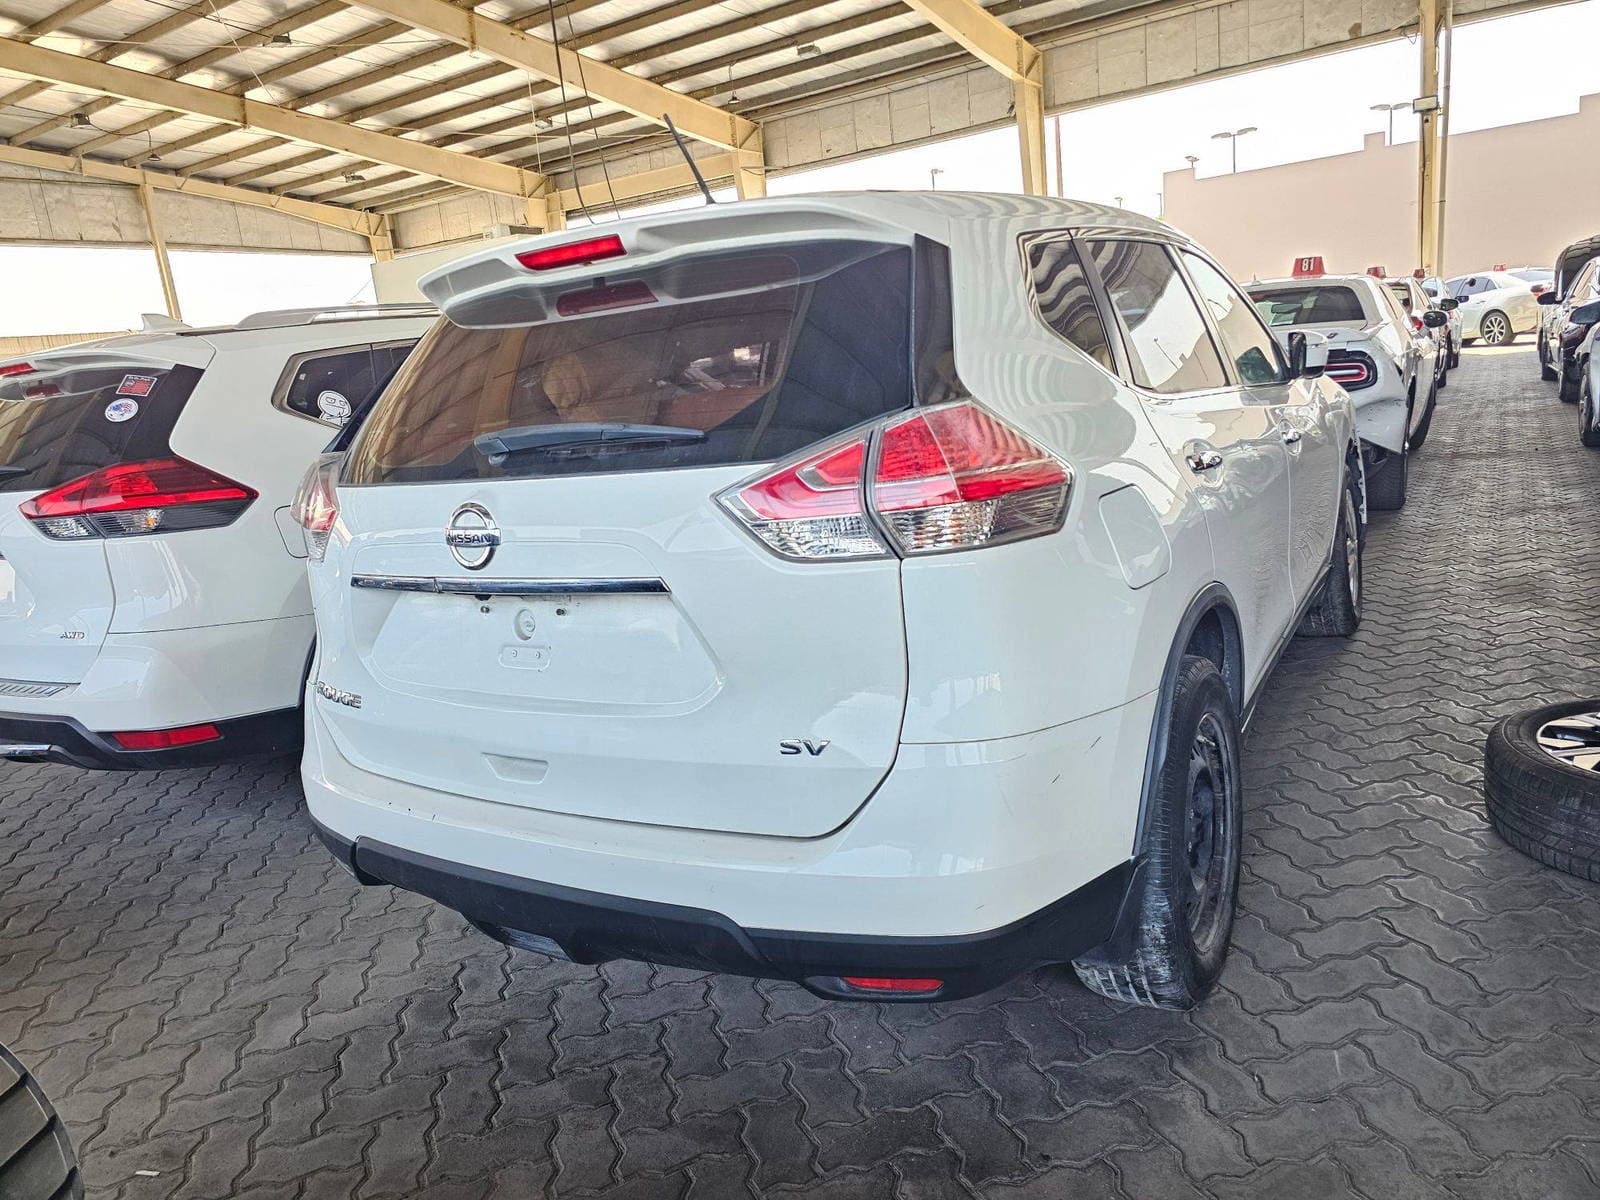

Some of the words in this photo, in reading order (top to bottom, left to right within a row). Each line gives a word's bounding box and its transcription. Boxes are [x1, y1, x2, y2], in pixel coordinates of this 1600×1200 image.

[1301, 257, 1315, 272] 81
[447, 533, 491, 544] NISSAN
[60, 631, 85, 640] AWD
[779, 738, 831, 756] SV
